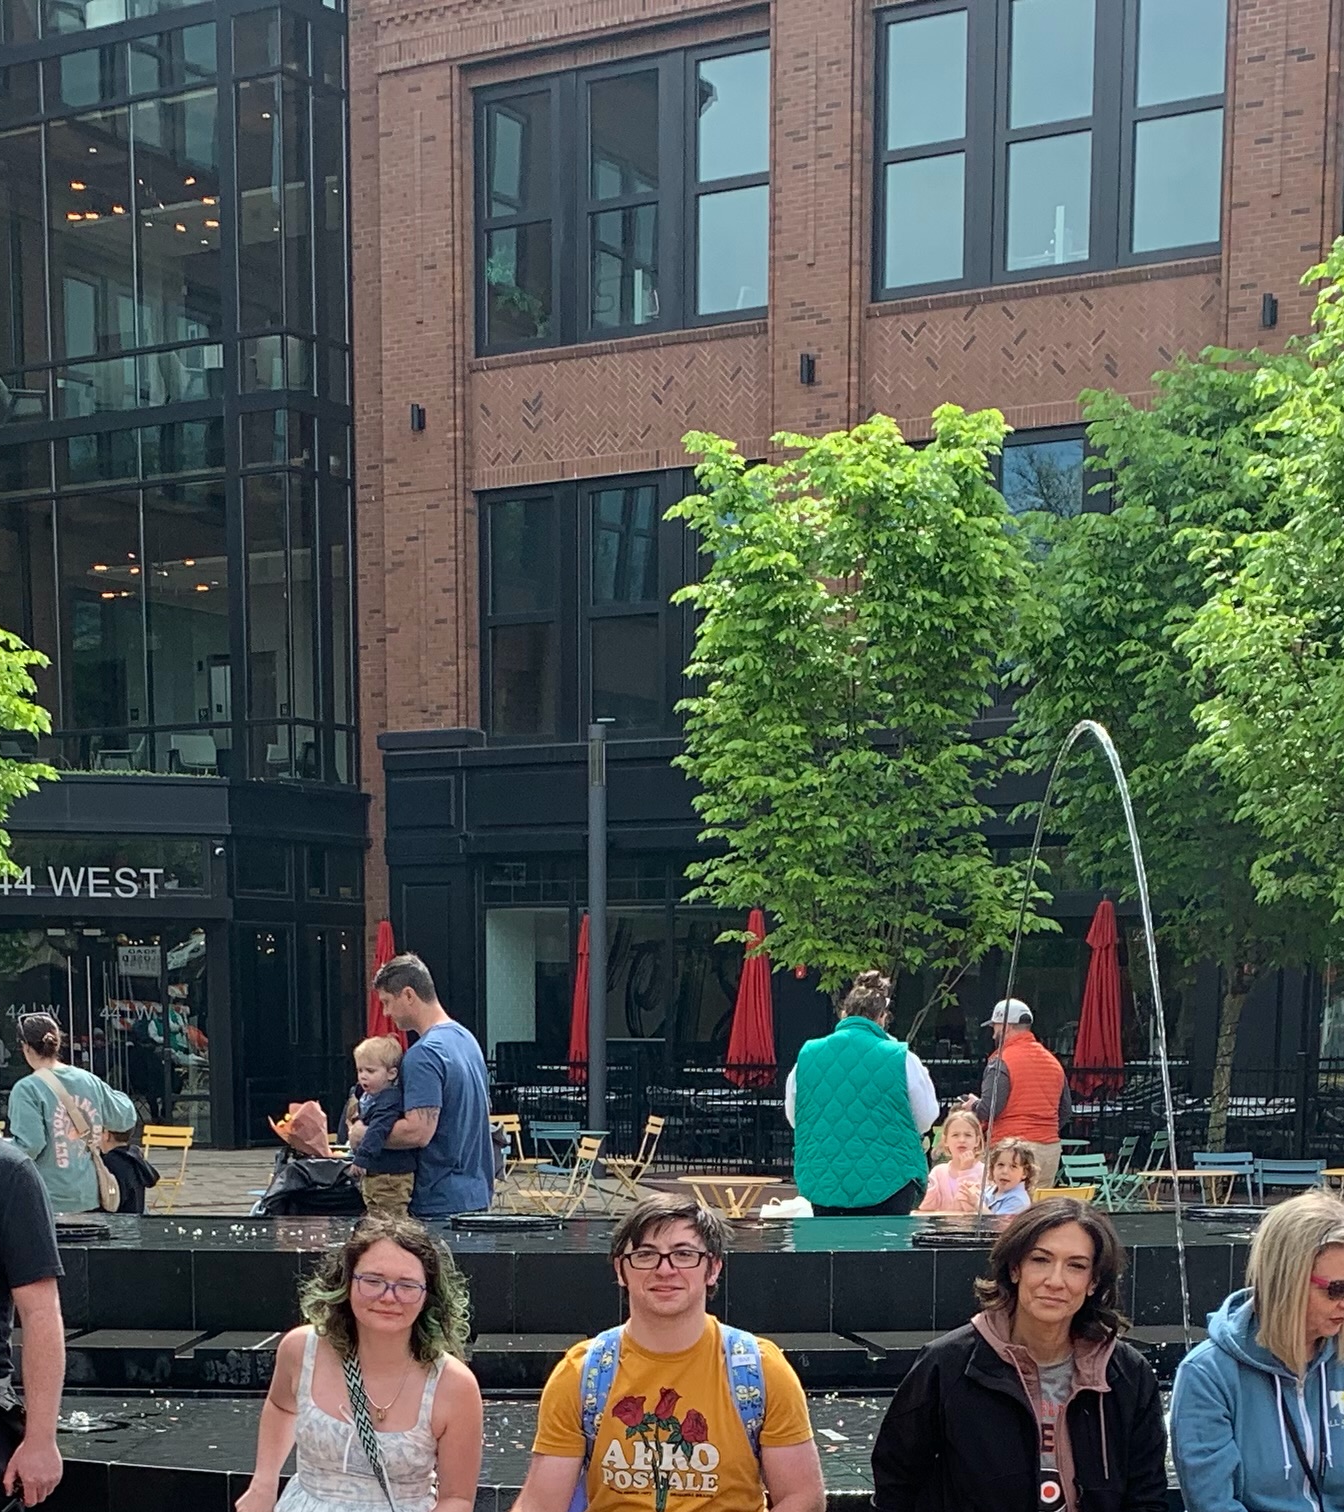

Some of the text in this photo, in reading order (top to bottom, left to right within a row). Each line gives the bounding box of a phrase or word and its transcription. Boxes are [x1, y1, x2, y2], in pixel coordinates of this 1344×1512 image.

[47, 866, 164, 898] WEST
[99, 1005, 121, 1020] 44
[601, 1439, 720, 1472] AERO
[601, 1467, 719, 1493] POSTALE
